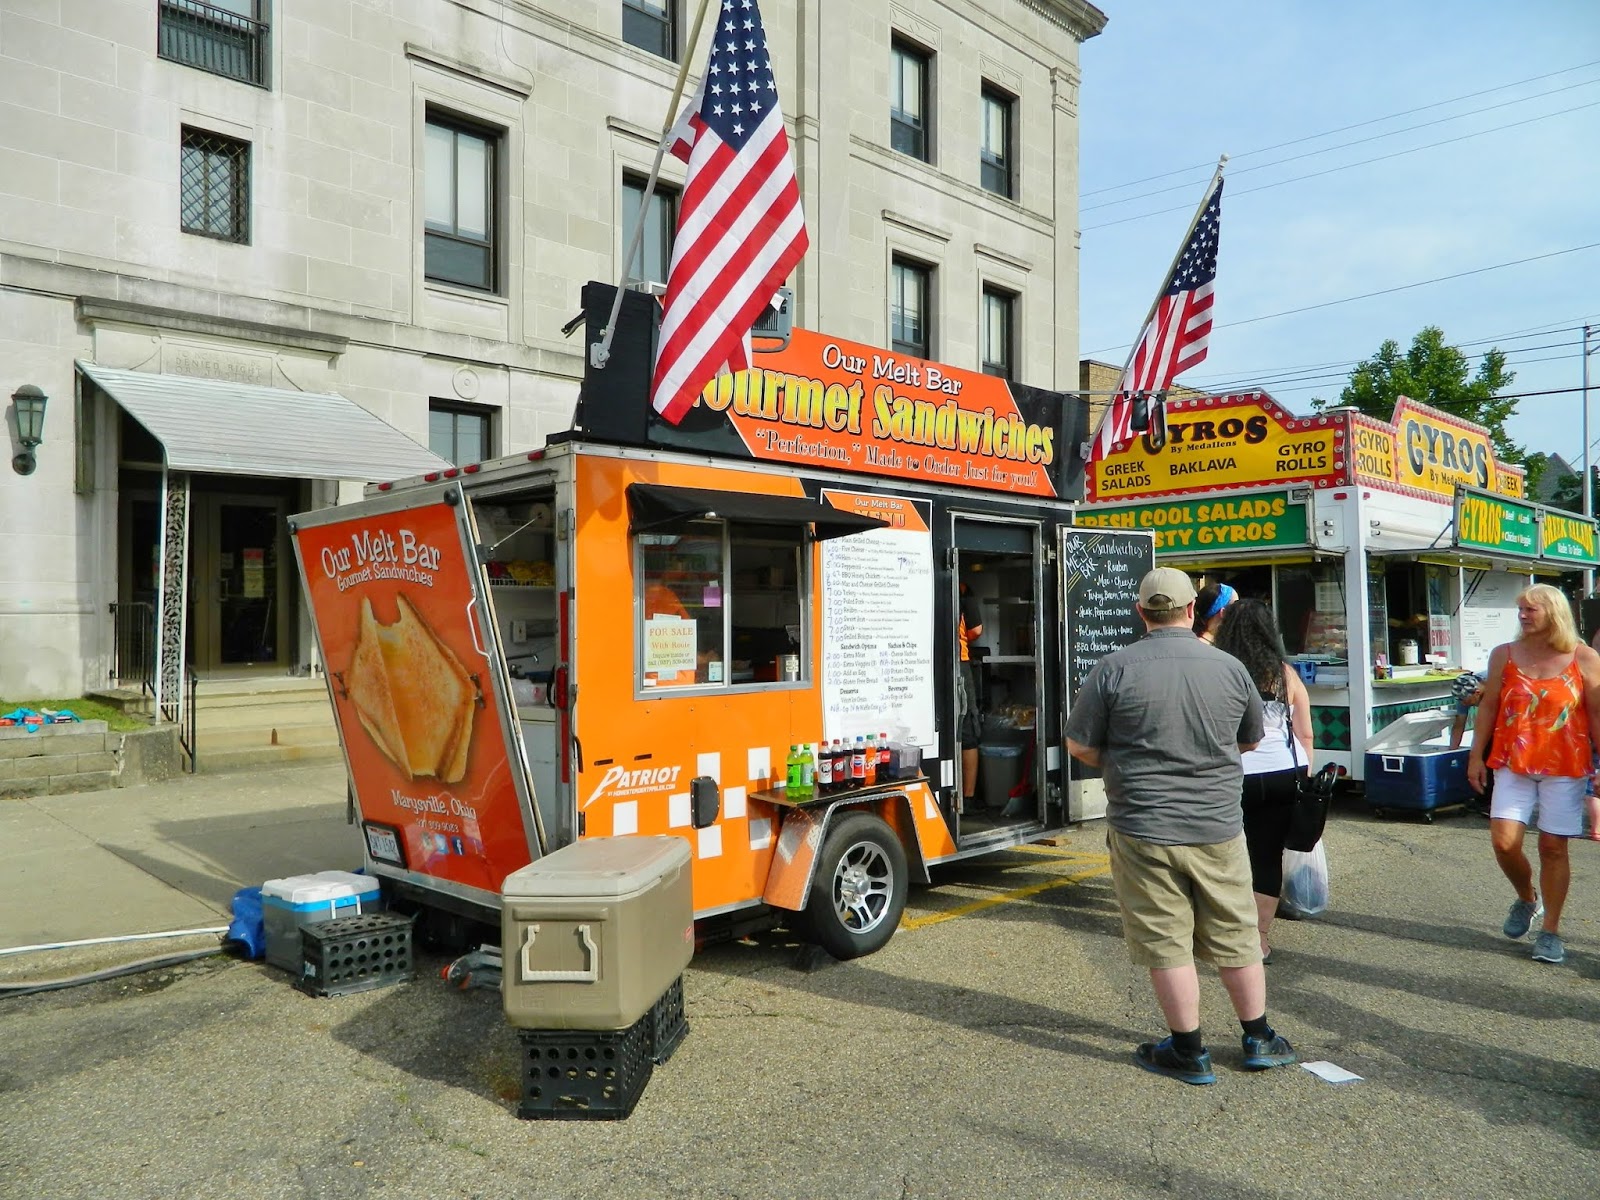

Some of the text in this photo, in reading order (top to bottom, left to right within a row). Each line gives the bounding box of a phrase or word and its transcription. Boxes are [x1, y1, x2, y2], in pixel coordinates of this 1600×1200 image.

[175, 366, 192, 374] OR
[176, 357, 220, 370] DENIED
[228, 363, 262, 375] RIGHT
[822, 344, 963, 395] Our Melt Bar
[692, 366, 1054, 466] ourmet Sandwiches
[1171, 446, 1183, 454] By
[1277, 440, 1326, 456] GYRO
[1359, 429, 1390, 455] GYRO
[1276, 456, 1327, 472] ROLLS
[1406, 419, 1489, 489] GYROS
[865, 445, 903, 469] Made
[906, 453, 920, 470] to
[923, 457, 960, 477] Order
[963, 459, 989, 480] Just
[991, 465, 1008, 484] for
[1104, 461, 1145, 477] GREEK
[1169, 457, 1237, 476] BAKLAVA
[1359, 453, 1392, 478] ROLLS
[1102, 474, 1151, 491] SALADS
[1430, 470, 1439, 487] By
[855, 498, 904, 510] Our Melt Bar
[1140, 507, 1193, 527] COOL
[1197, 498, 1286, 522] SALADS
[1460, 497, 1502, 545] GYROS
[1197, 522, 1277, 545] GYROS
[1542, 514, 1594, 557] GREEK SALADS
[321, 529, 442, 578] Our Melt Bar
[1066, 535, 1083, 553] OUR
[1079, 557, 1099, 579] BAR
[1107, 560, 1129, 573] Reuben
[337, 562, 433, 592] Gourmet Sandwiches
[1097, 574, 1111, 588] Mac
[649, 627, 694, 637] FOR SALE
[651, 641, 690, 650] With Route
[583, 765, 682, 809] PATRIOT
[391, 789, 477, 820] Marysville, Ohio
